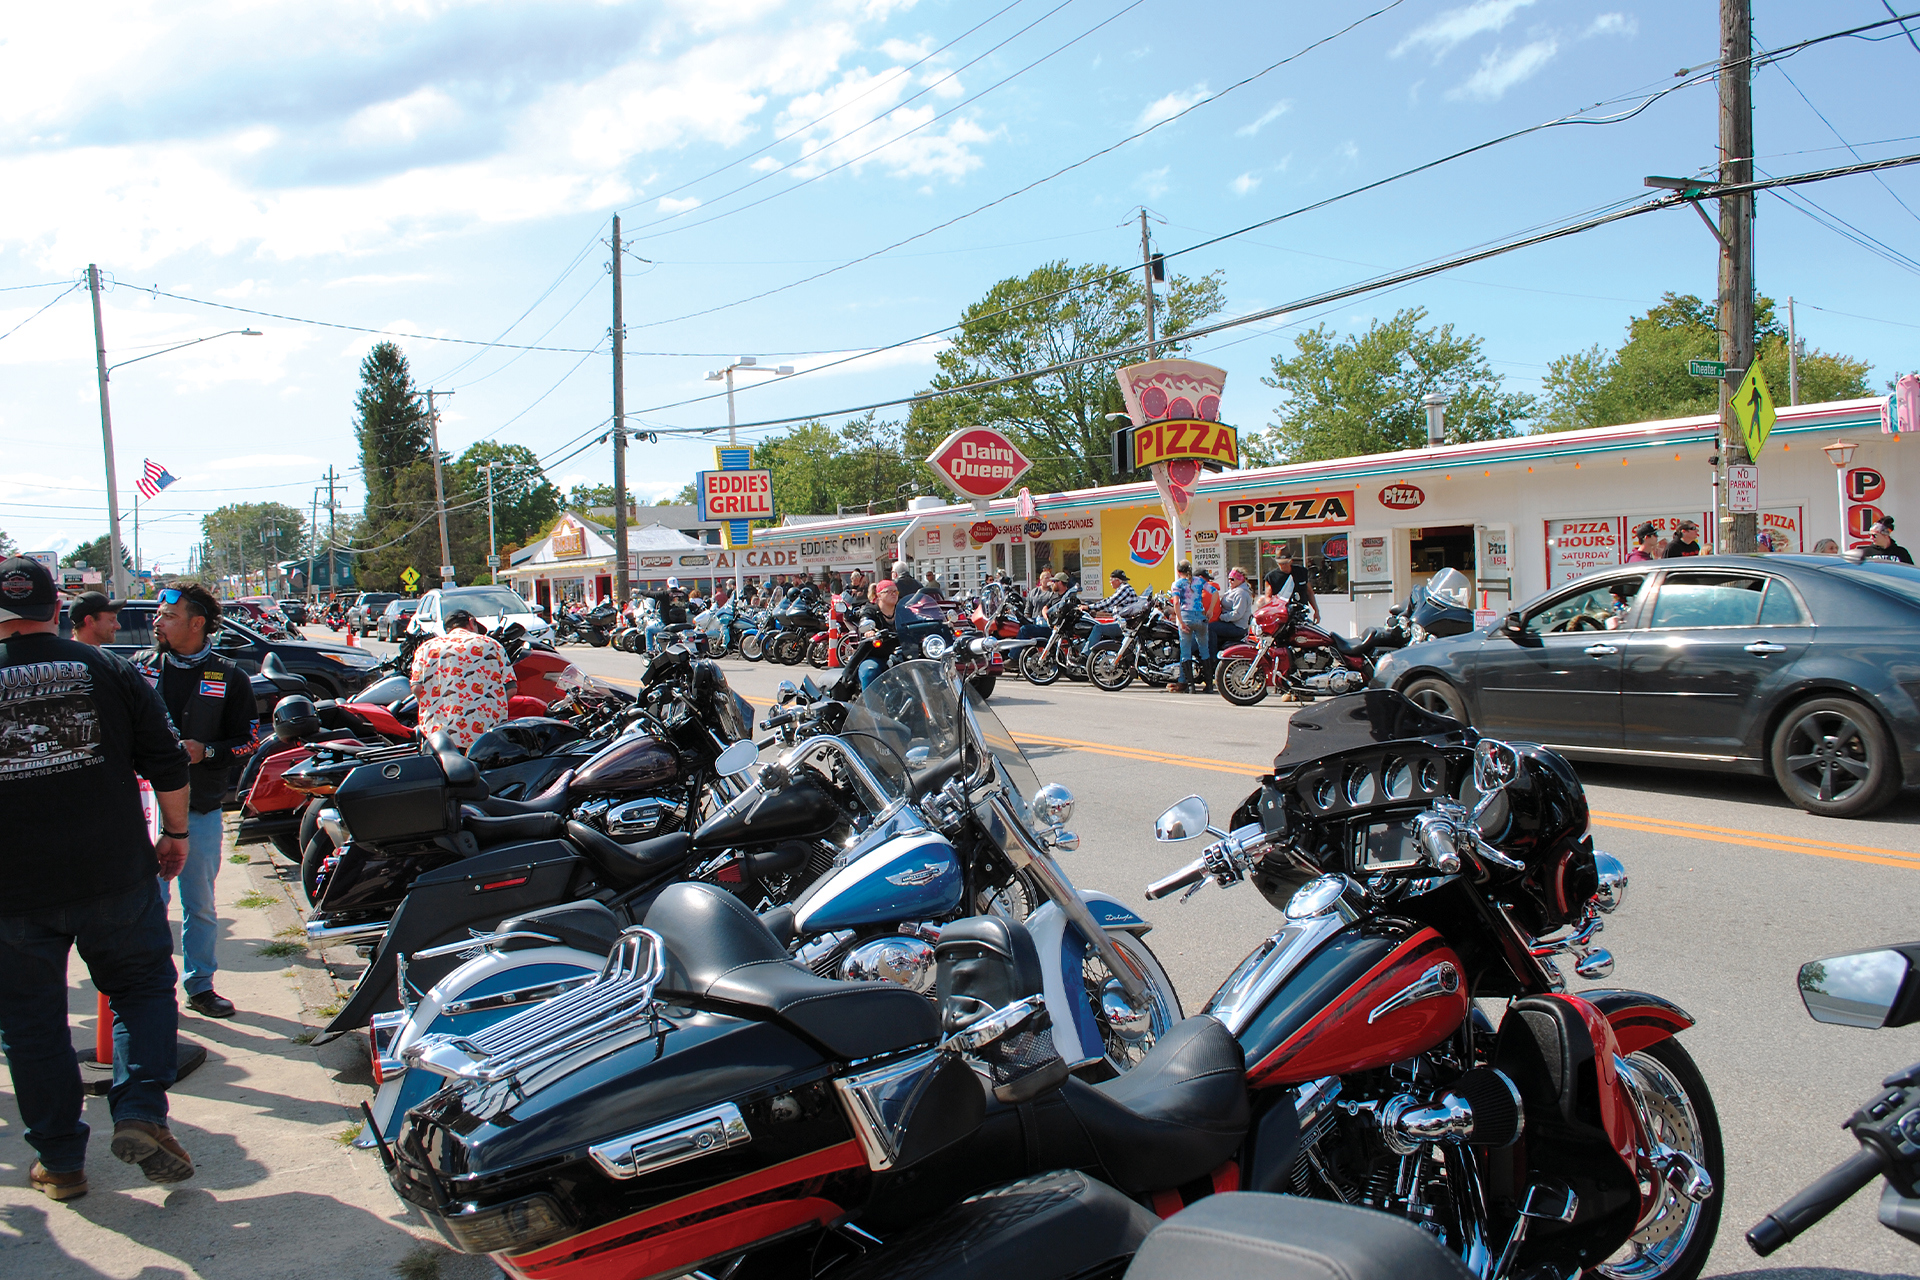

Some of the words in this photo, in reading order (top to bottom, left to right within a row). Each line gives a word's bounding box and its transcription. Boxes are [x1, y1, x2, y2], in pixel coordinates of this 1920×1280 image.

[1691, 362, 1717, 375] Theater
[962, 442, 1014, 464] Dairy
[1137, 424, 1236, 466] PIZZA
[951, 458, 1014, 480] Queen
[1737, 470, 1749, 479] NO
[708, 474, 768, 494] EDDIE'S
[1730, 480, 1756, 489] PARKING
[709, 495, 770, 513] GRILL
[1563, 522, 1610, 535] PIZZA
[1763, 513, 1796, 532] PIZZA
[1136, 527, 1166, 555] DQ
[1326, 540, 1348, 557] OPE
[1557, 535, 1616, 548] HOURS
[715, 550, 798, 568] ACADE
[1561, 551, 1610, 560] SATURDAY
[1575, 560, 1595, 570] 5pm
[0, 661, 92, 690] UNDER
[25, 758, 51, 769] BIKE
[52, 751, 85, 764] RALLY
